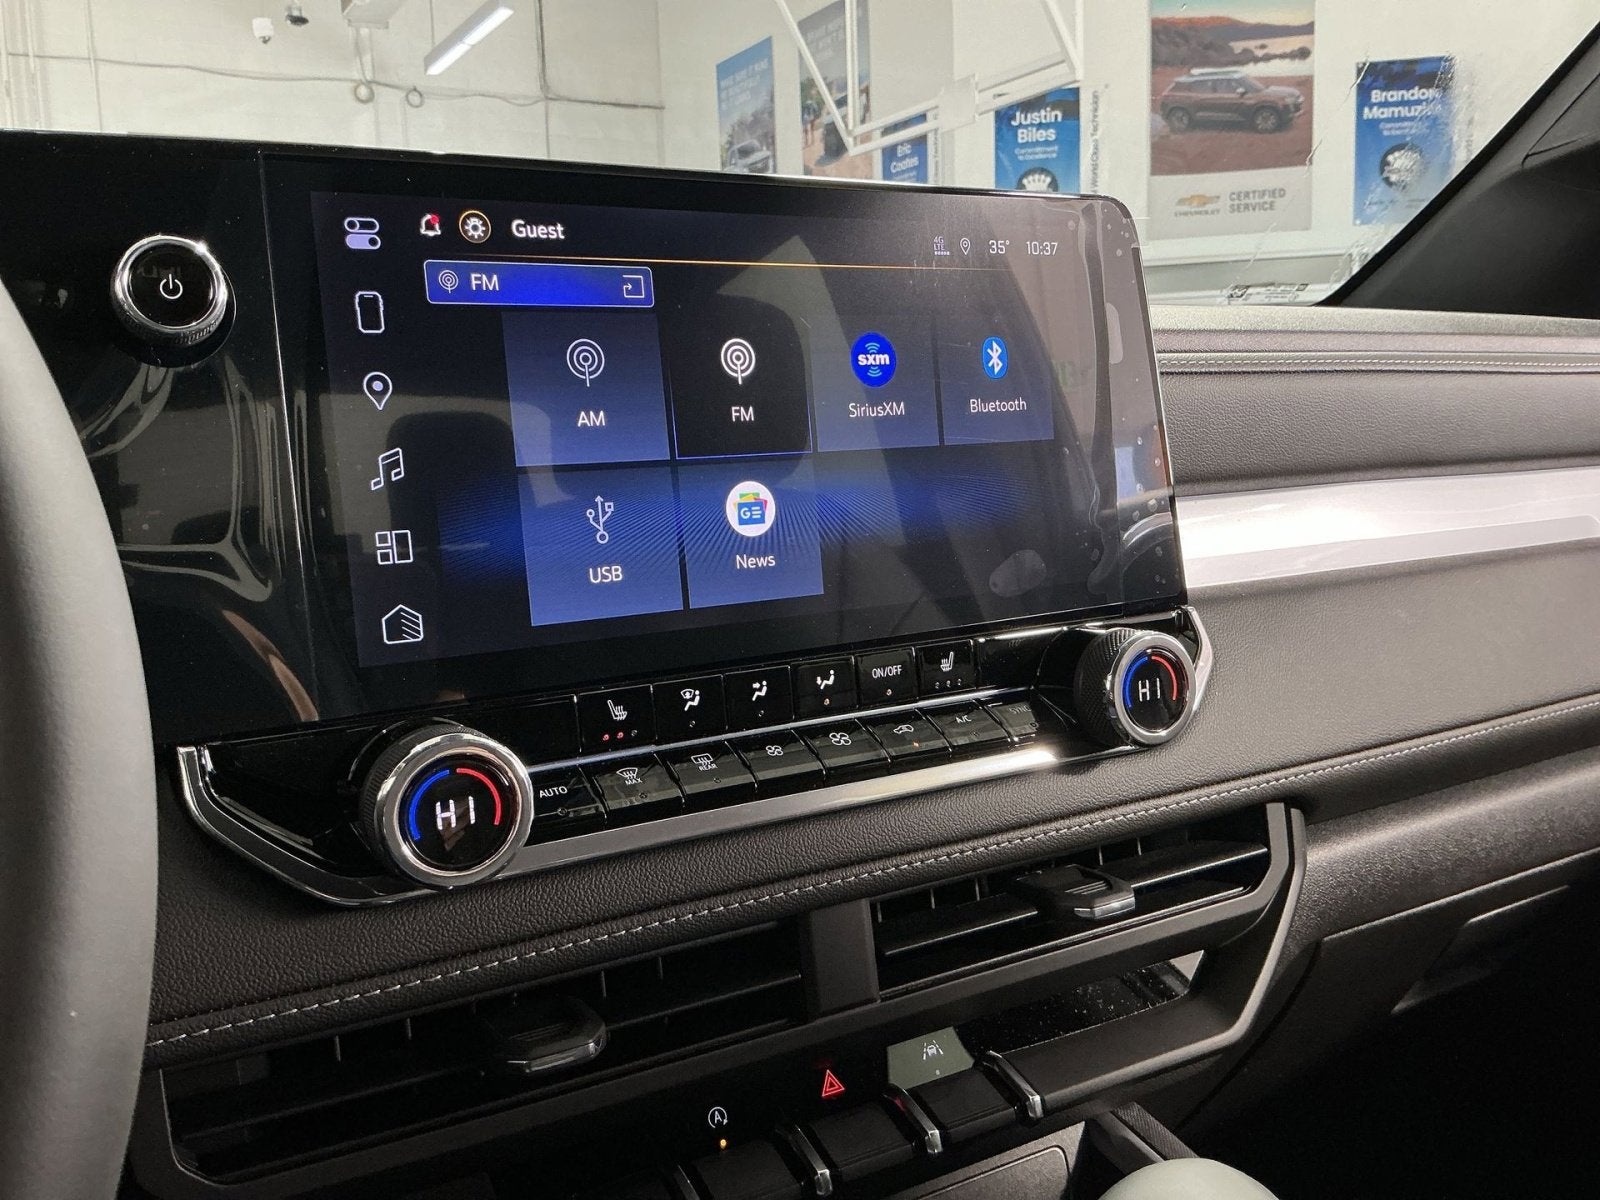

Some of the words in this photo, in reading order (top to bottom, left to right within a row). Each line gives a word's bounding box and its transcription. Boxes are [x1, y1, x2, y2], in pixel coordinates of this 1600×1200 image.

[1011, 107, 1063, 126] Justin
[1017, 126, 1057, 143] Biles
[1229, 188, 1286, 202] CERTIFIED
[1228, 201, 1276, 214] SERVICE
[511, 219, 565, 239] Guest
[933, 243, 945, 251] LTE
[989, 239, 1010, 254] 35°
[1026, 241, 1058, 255] 10:37
[470, 273, 500, 292] FM
[857, 353, 890, 367] sxm
[848, 401, 905, 419] SiriusXM
[969, 397, 1028, 414] Bluetooth
[577, 410, 606, 428] AM
[731, 406, 755, 423] FM
[735, 553, 776, 570] News
[589, 565, 623, 584] USB
[872, 664, 902, 679] ON/OFF
[698, 762, 719, 772] REAR
[625, 777, 643, 786] MAX
[538, 785, 568, 799] AUTO
[435, 796, 476, 831] HI
